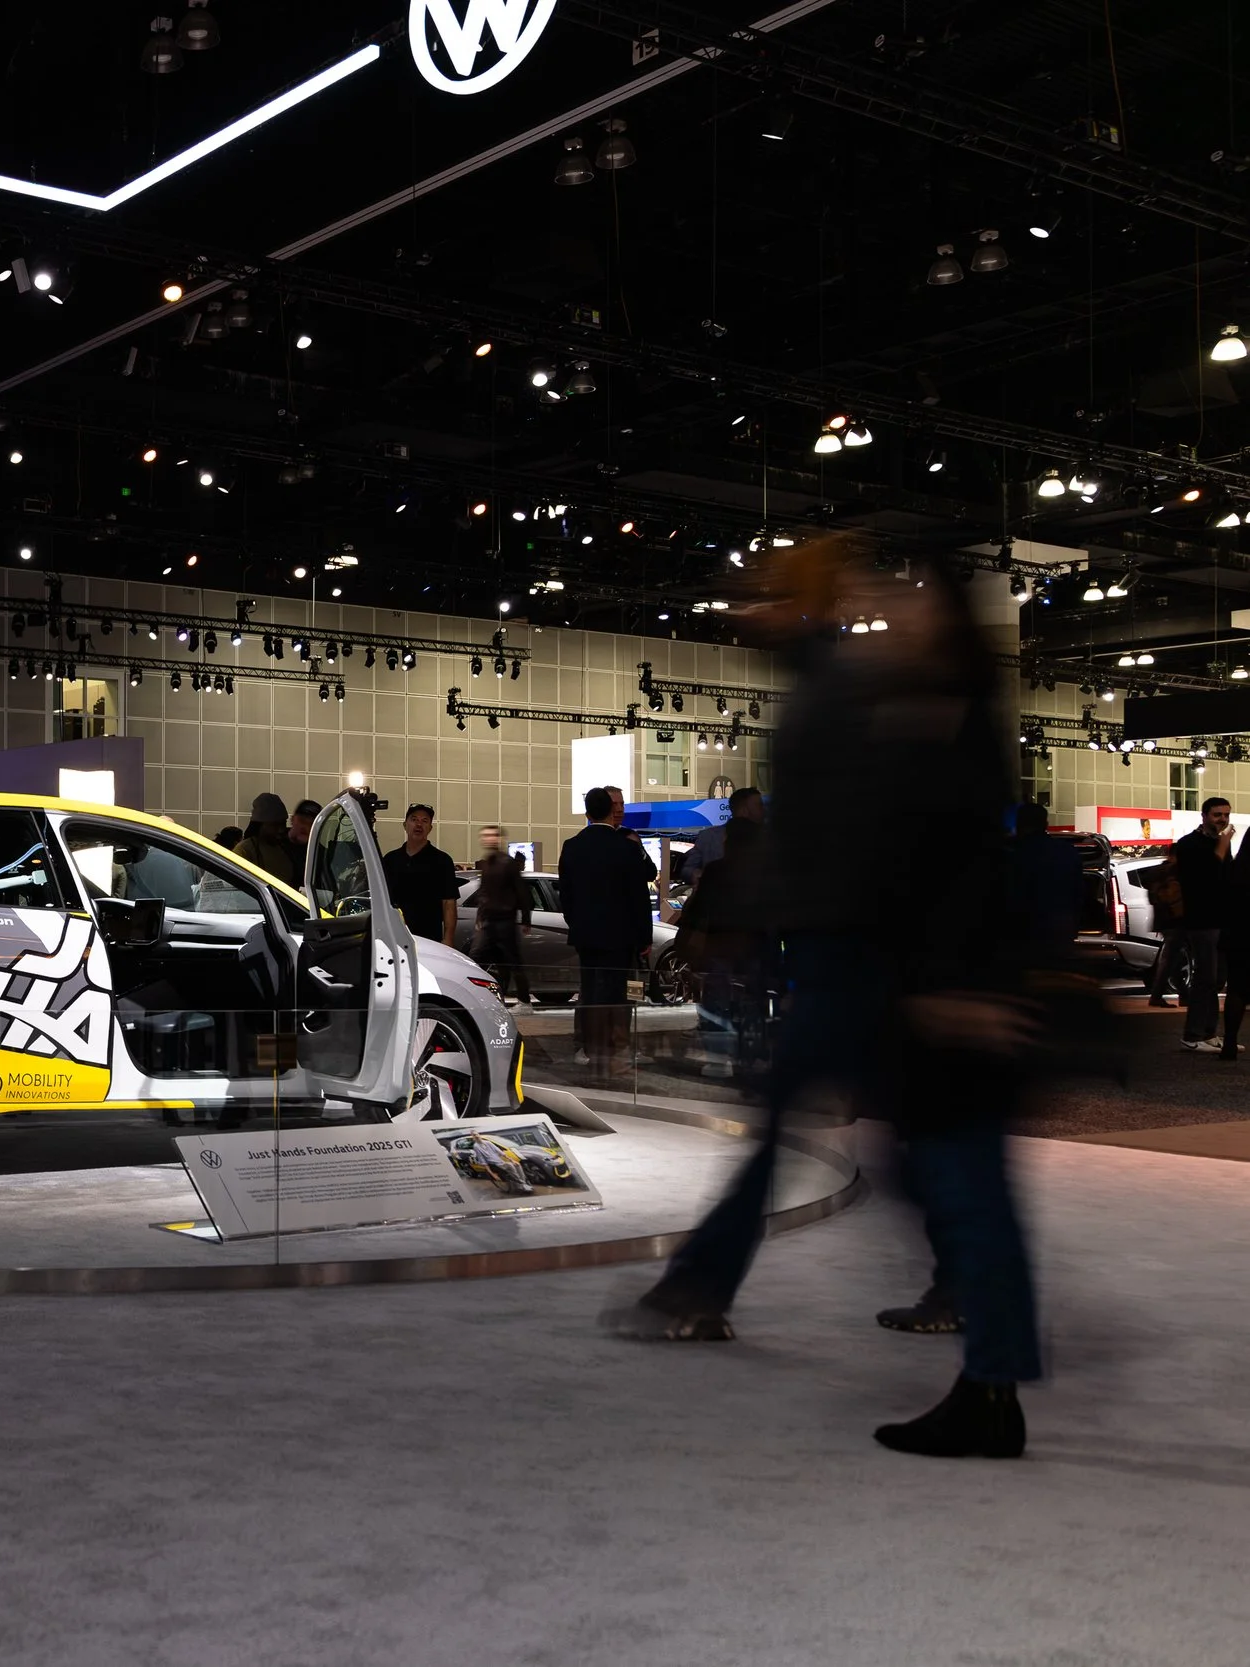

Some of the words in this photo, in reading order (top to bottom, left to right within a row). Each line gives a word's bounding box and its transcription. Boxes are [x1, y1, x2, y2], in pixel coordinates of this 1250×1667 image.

[8, 1073, 72, 1087] MOBILITY
[6, 1090, 70, 1100] INNOVATIONS
[247, 1150, 271, 1160] Just
[271, 1147, 306, 1158] Hands
[308, 1143, 366, 1155] Foundation
[368, 1141, 393, 1151] 2025
[394, 1139, 412, 1149] GTI
